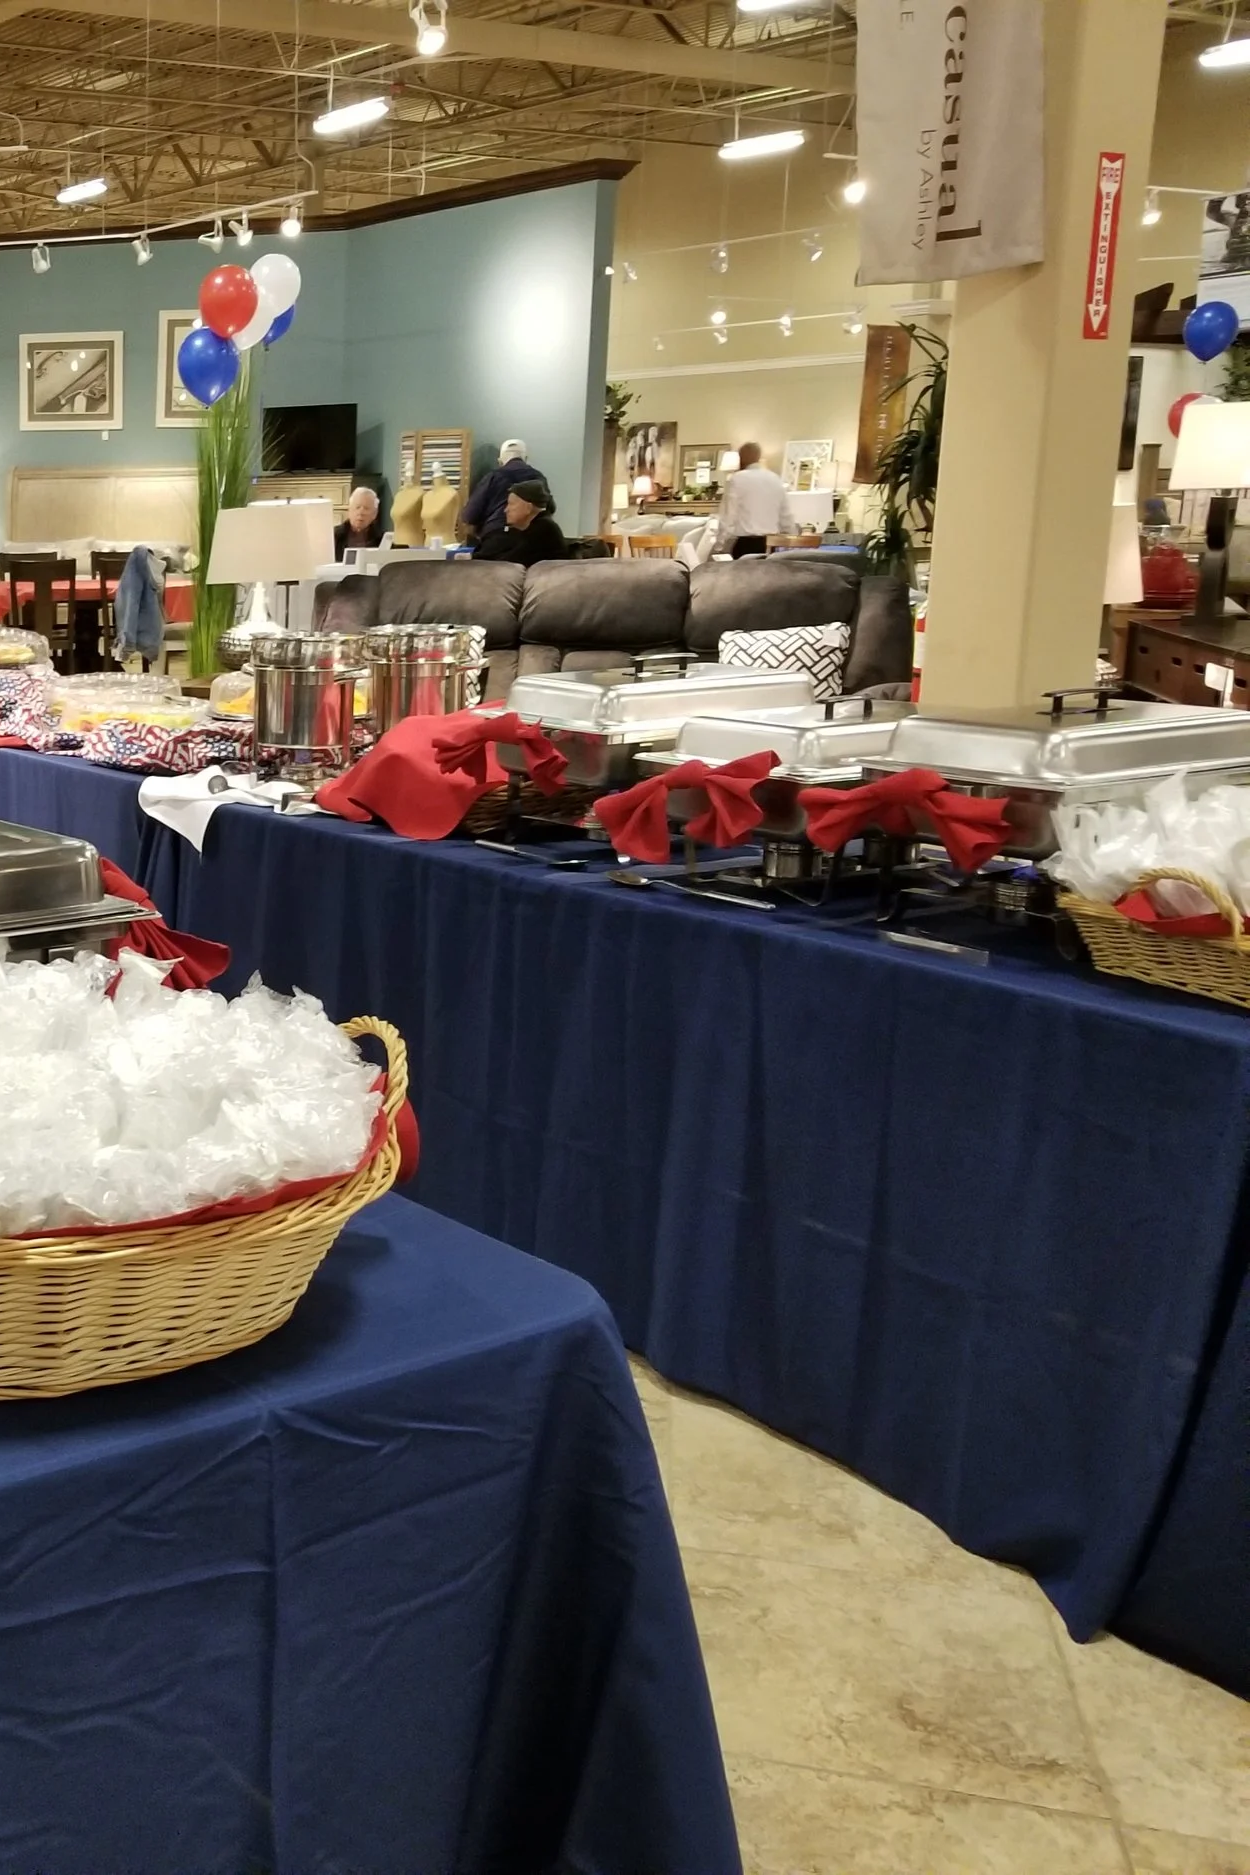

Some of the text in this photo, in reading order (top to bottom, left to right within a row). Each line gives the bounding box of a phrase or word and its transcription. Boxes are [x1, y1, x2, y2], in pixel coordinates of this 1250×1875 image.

[935, 5, 982, 242] casual
[1102, 166, 1121, 183] FIRE
[911, 129, 937, 250] by Ashley
[1093, 191, 1112, 317] EXTINGUISHER
